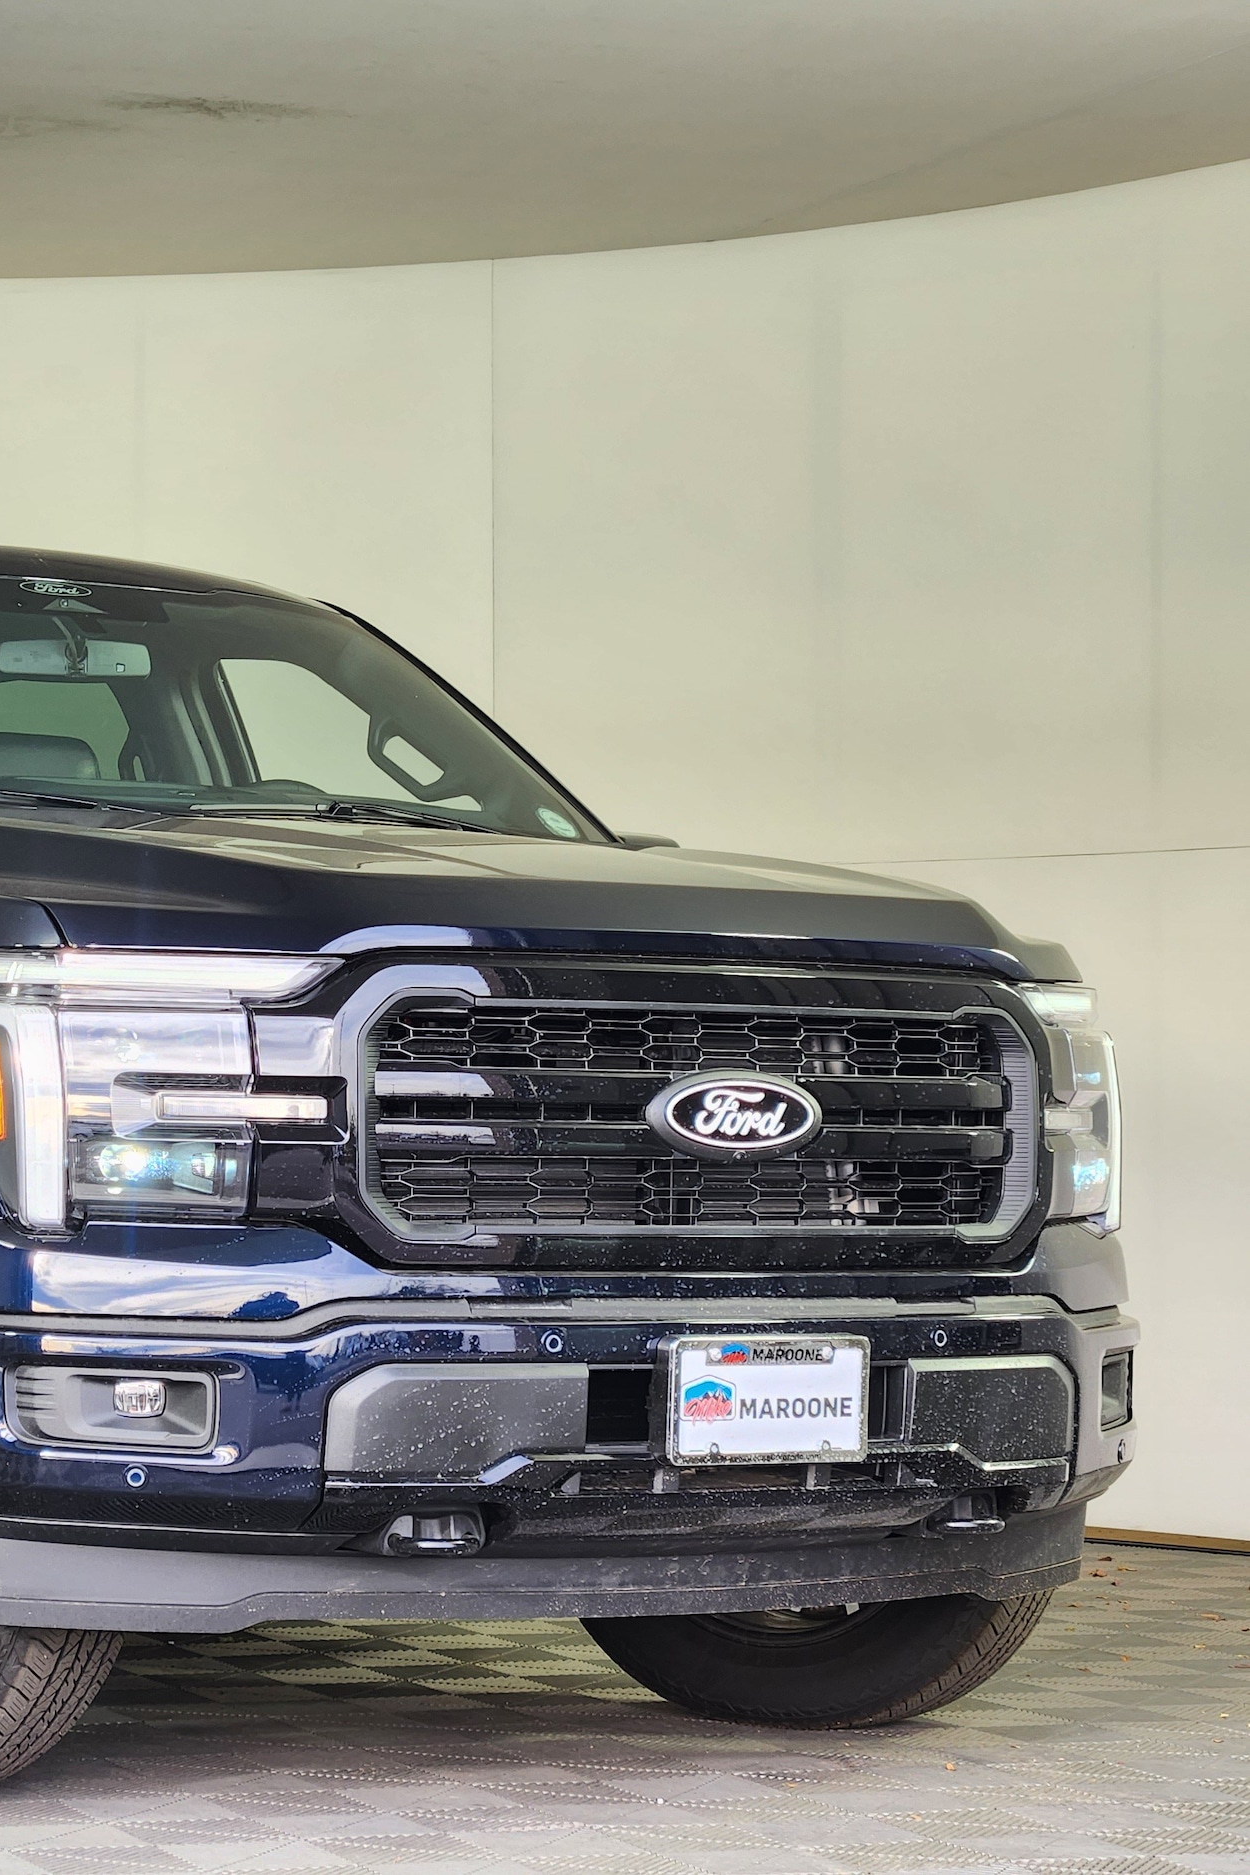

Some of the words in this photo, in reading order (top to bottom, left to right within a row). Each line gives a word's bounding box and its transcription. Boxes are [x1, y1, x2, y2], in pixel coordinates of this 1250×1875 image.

[34, 582, 80, 595] Ford
[693, 1087, 788, 1137] Ford
[752, 1348, 823, 1362] MAROONE
[739, 1397, 853, 1419] MAROONE
